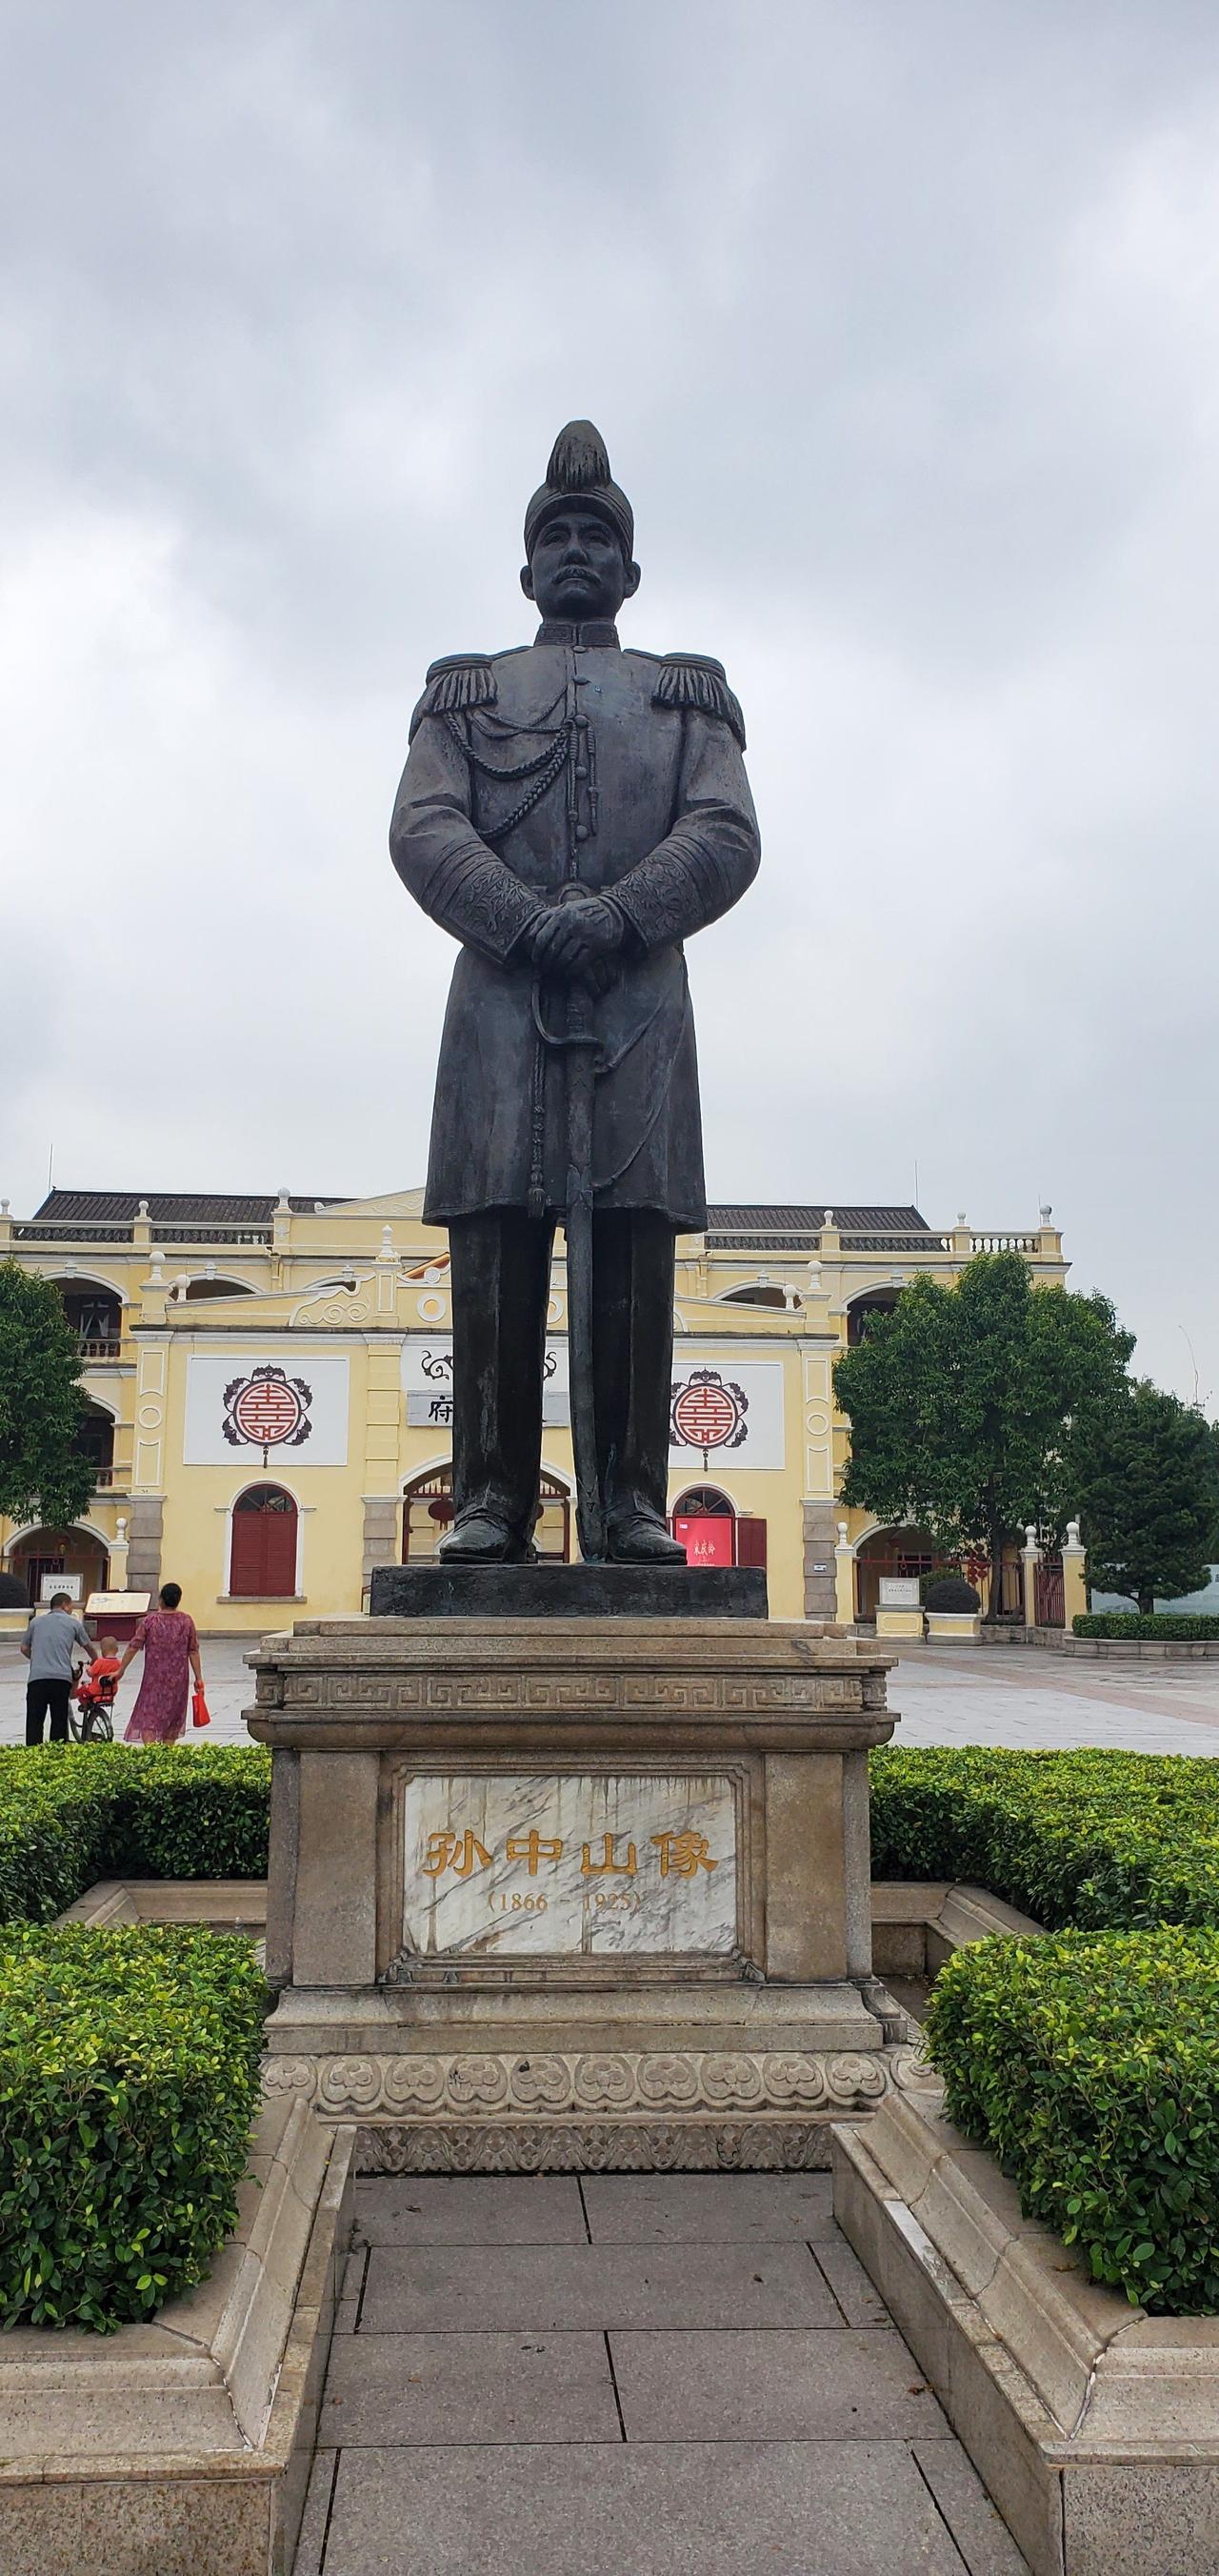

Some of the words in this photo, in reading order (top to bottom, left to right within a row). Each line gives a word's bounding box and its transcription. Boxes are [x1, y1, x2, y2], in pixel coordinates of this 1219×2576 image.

[423, 1828, 720, 1880] 孙中山像
[488, 1890, 549, 1912] (1866
[582, 1890, 641, 1914] 1925)
